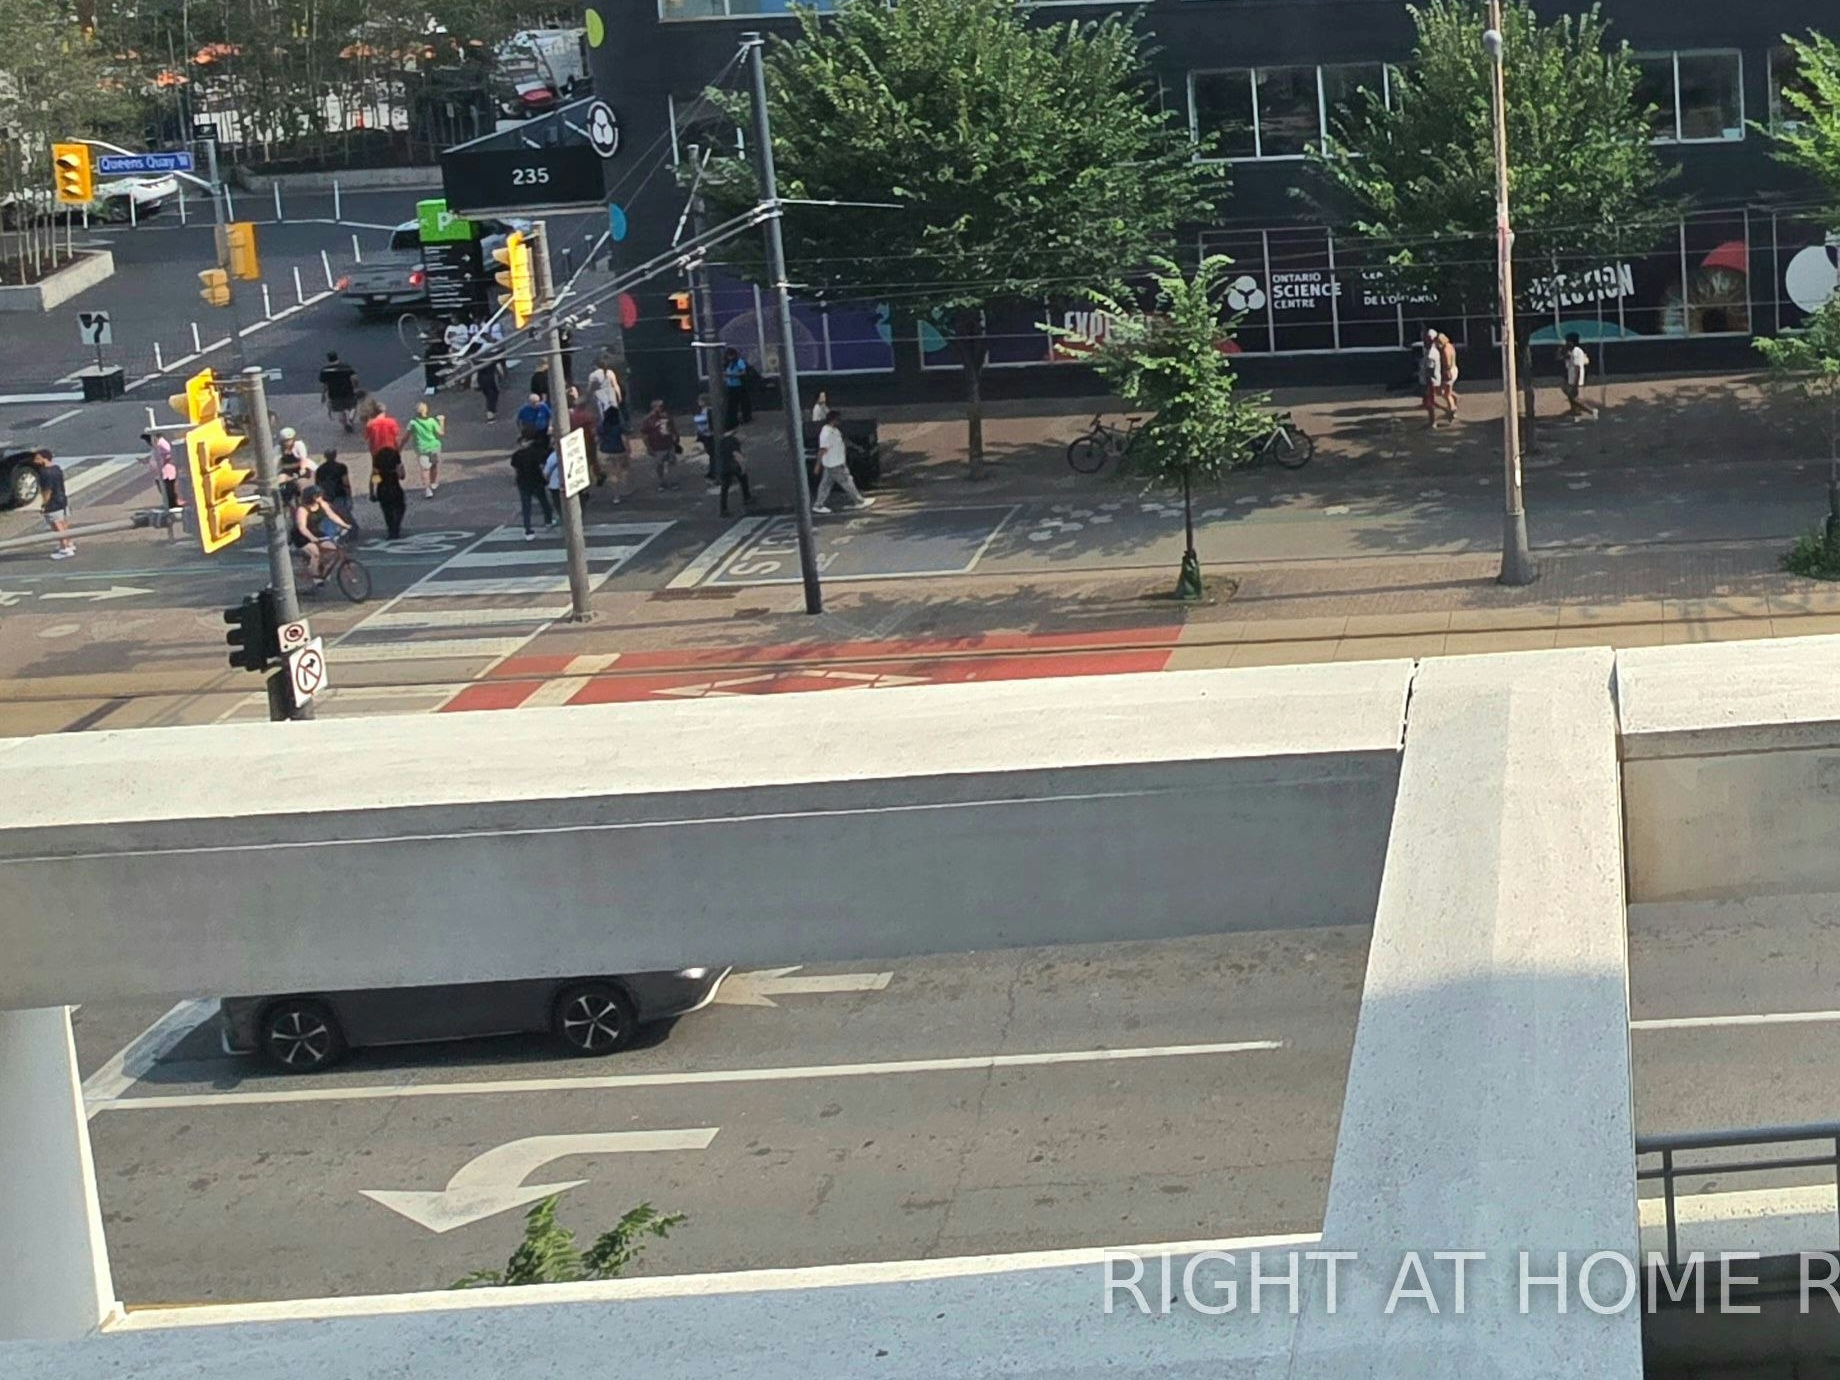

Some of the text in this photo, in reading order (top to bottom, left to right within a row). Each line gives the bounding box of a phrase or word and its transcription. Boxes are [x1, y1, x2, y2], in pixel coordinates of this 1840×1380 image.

[101, 158, 144, 170] Queens
[146, 156, 175, 170] Quay
[512, 167, 549, 185] 235
[1272, 272, 1322, 283] ONTARIO
[1272, 282, 1342, 298] SCIENCE
[1274, 298, 1316, 309] CENTRE
